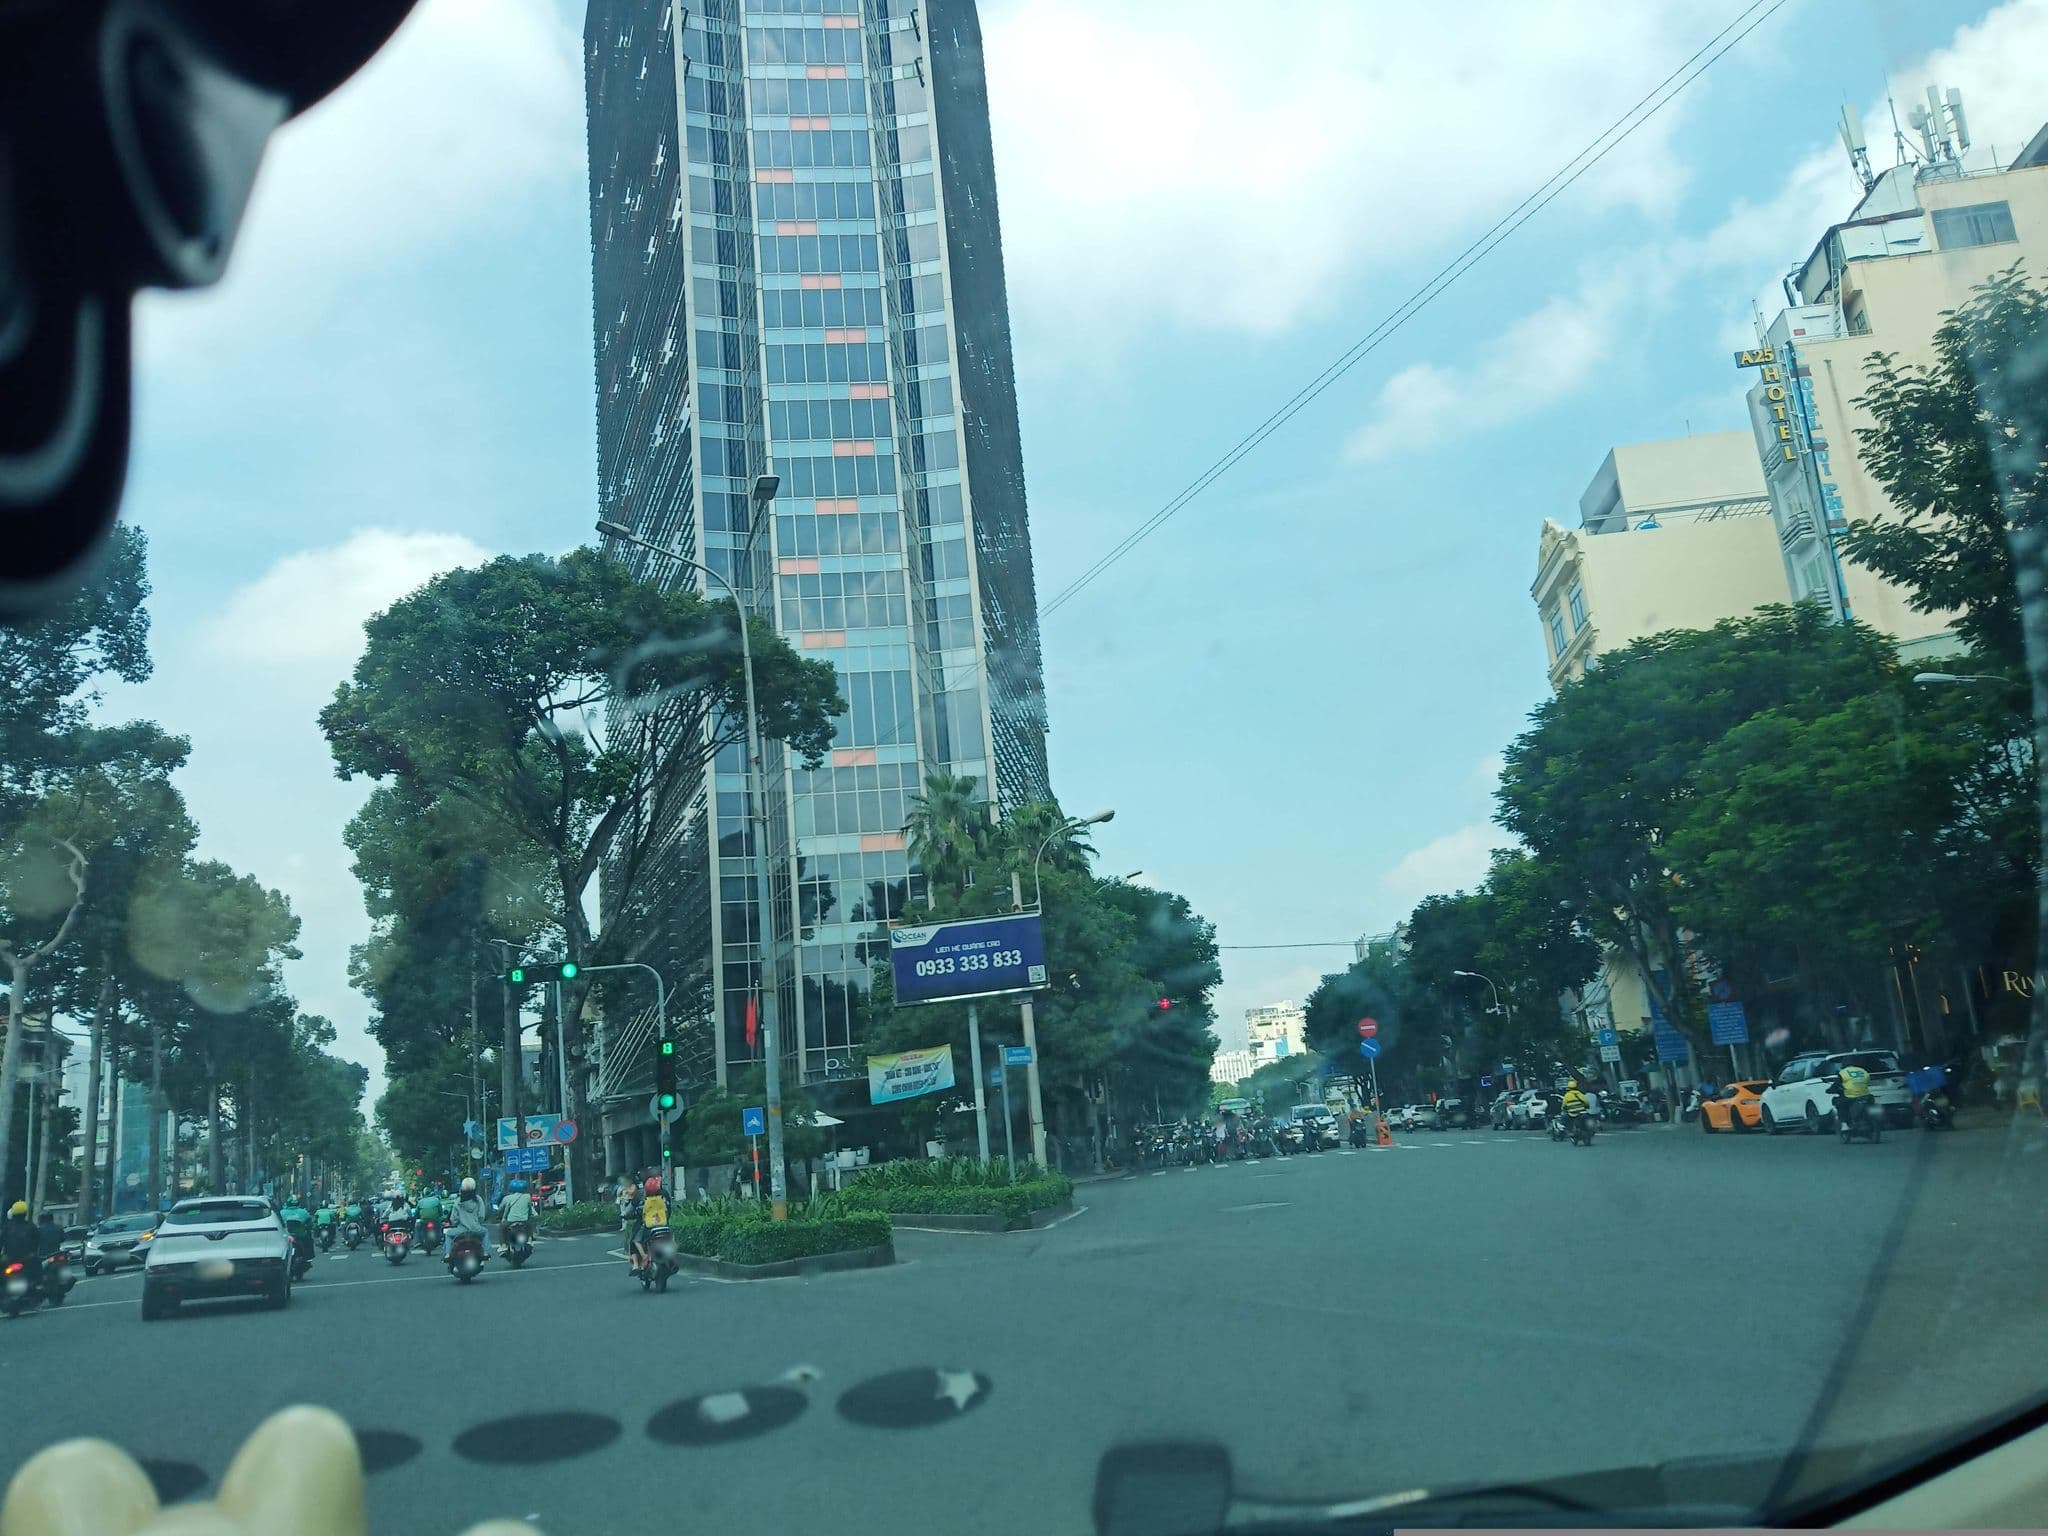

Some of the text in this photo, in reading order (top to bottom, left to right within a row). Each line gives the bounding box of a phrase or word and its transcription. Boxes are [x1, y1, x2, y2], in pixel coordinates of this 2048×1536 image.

[1741, 349, 1774, 364] A25
[1764, 366, 1797, 460] HOTEL
[902, 932, 927, 940] OCEAN
[916, 949, 1022, 976] 0933 333 833
[1605, 1032, 1612, 1041] P
